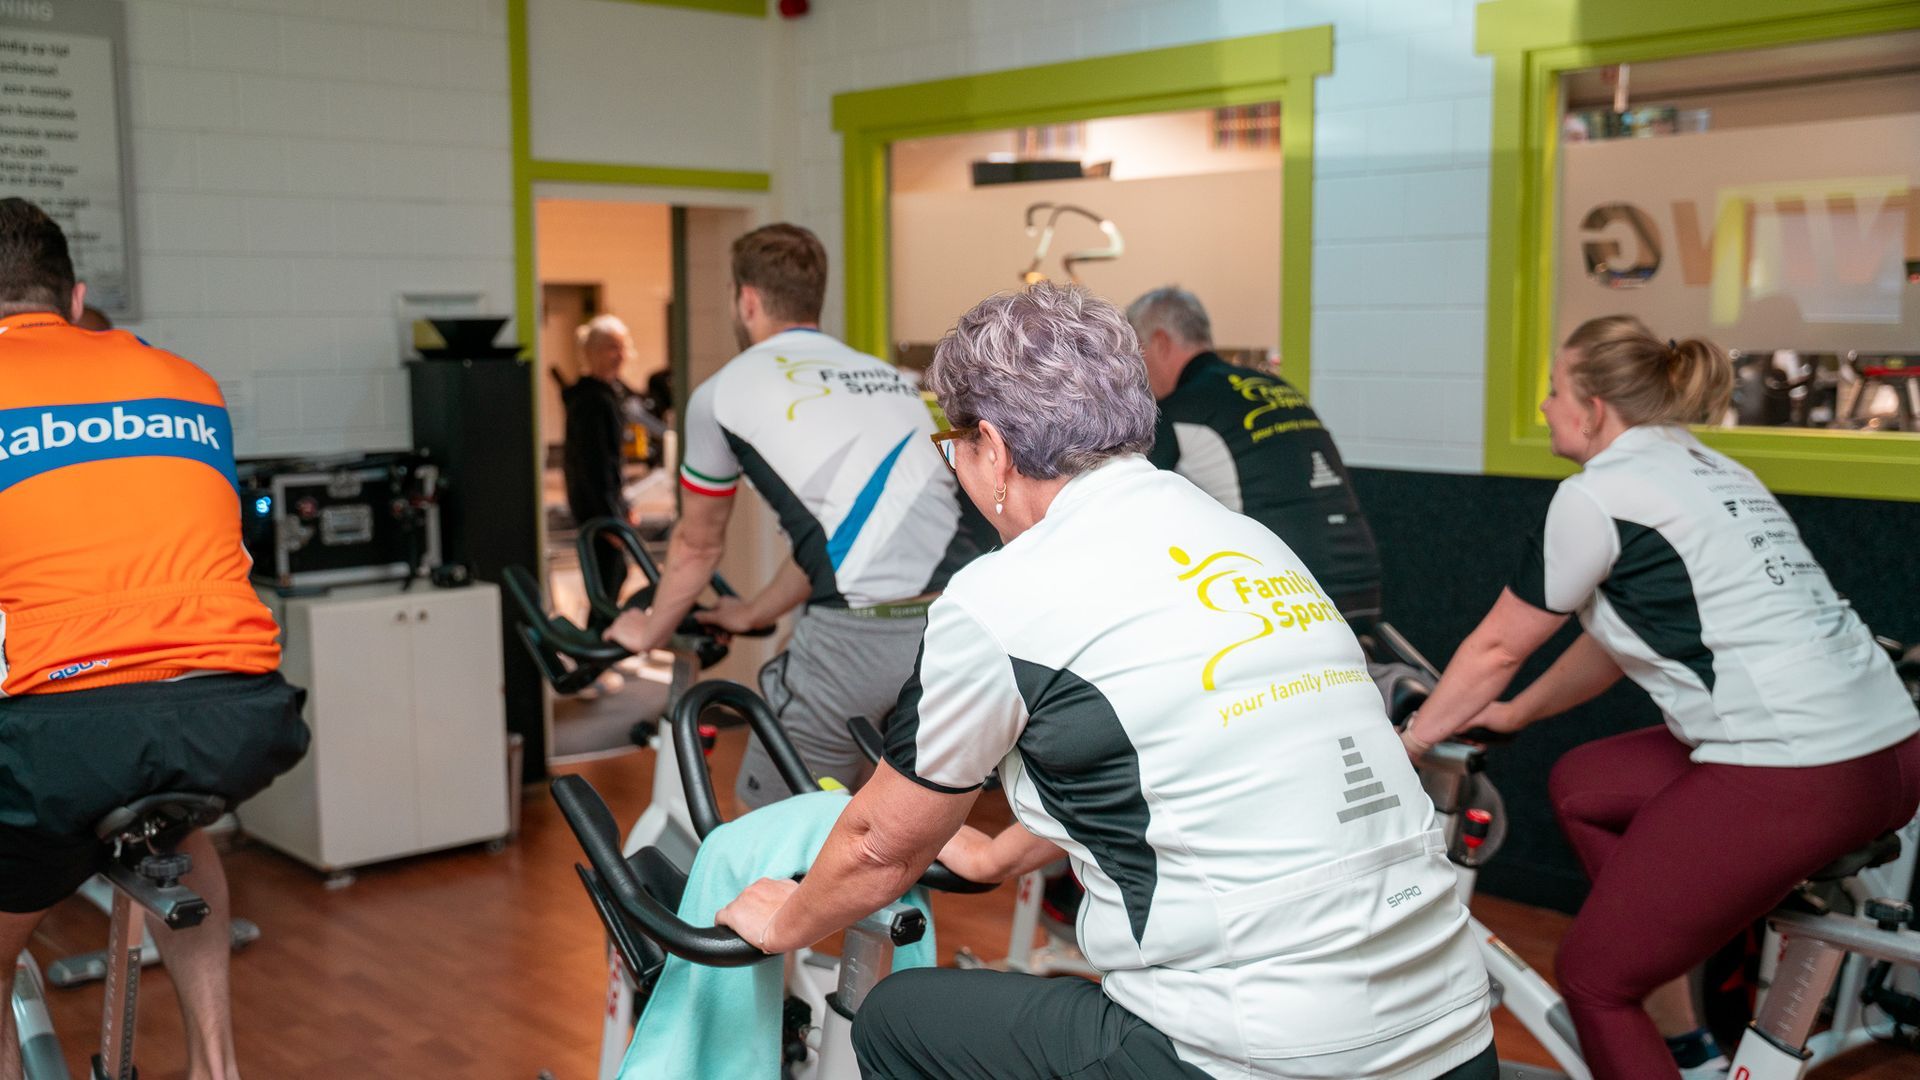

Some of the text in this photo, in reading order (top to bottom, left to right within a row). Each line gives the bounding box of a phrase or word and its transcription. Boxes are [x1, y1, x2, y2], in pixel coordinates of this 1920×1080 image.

[819, 368, 900, 382] Family
[1231, 569, 1321, 604] Family
[1219, 669, 1364, 728] your family fitness
[1386, 885, 1422, 908] SPIRO
